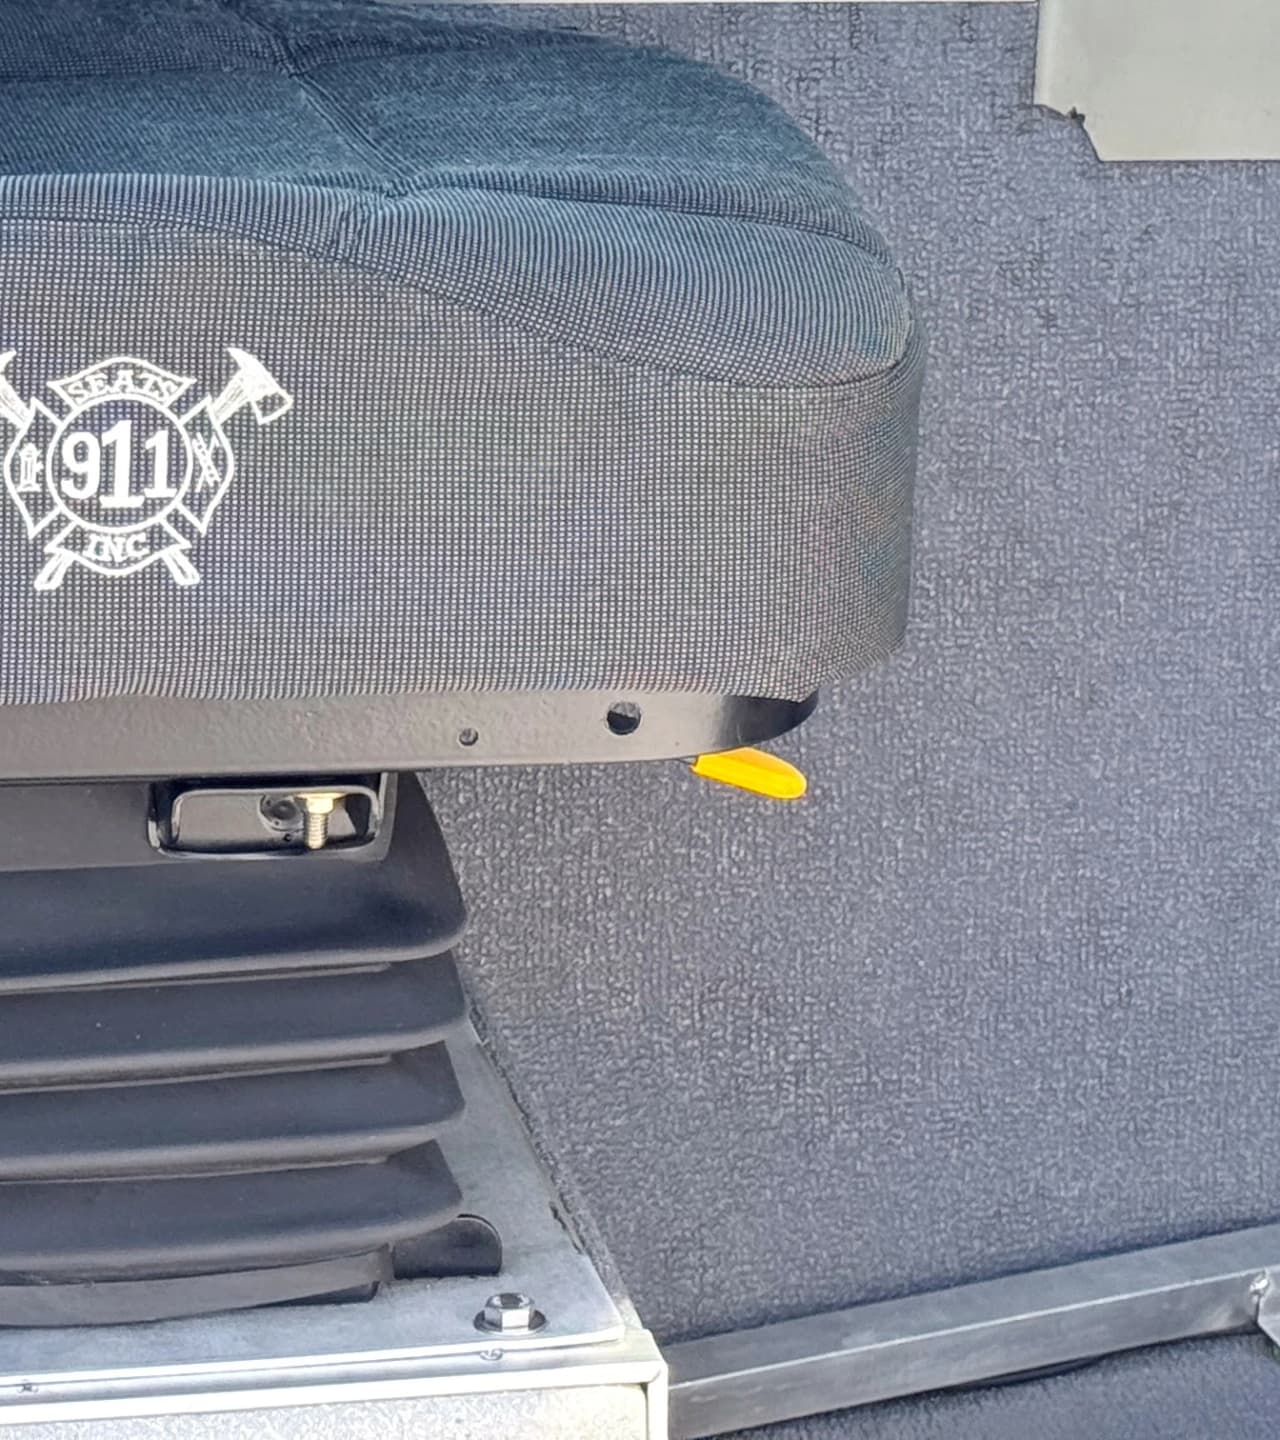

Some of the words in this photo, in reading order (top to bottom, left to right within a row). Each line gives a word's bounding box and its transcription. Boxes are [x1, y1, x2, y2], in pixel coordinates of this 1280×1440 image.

[67, 369, 178, 404] SEATS
[60, 419, 177, 508] 911
[81, 531, 150, 563] INC
